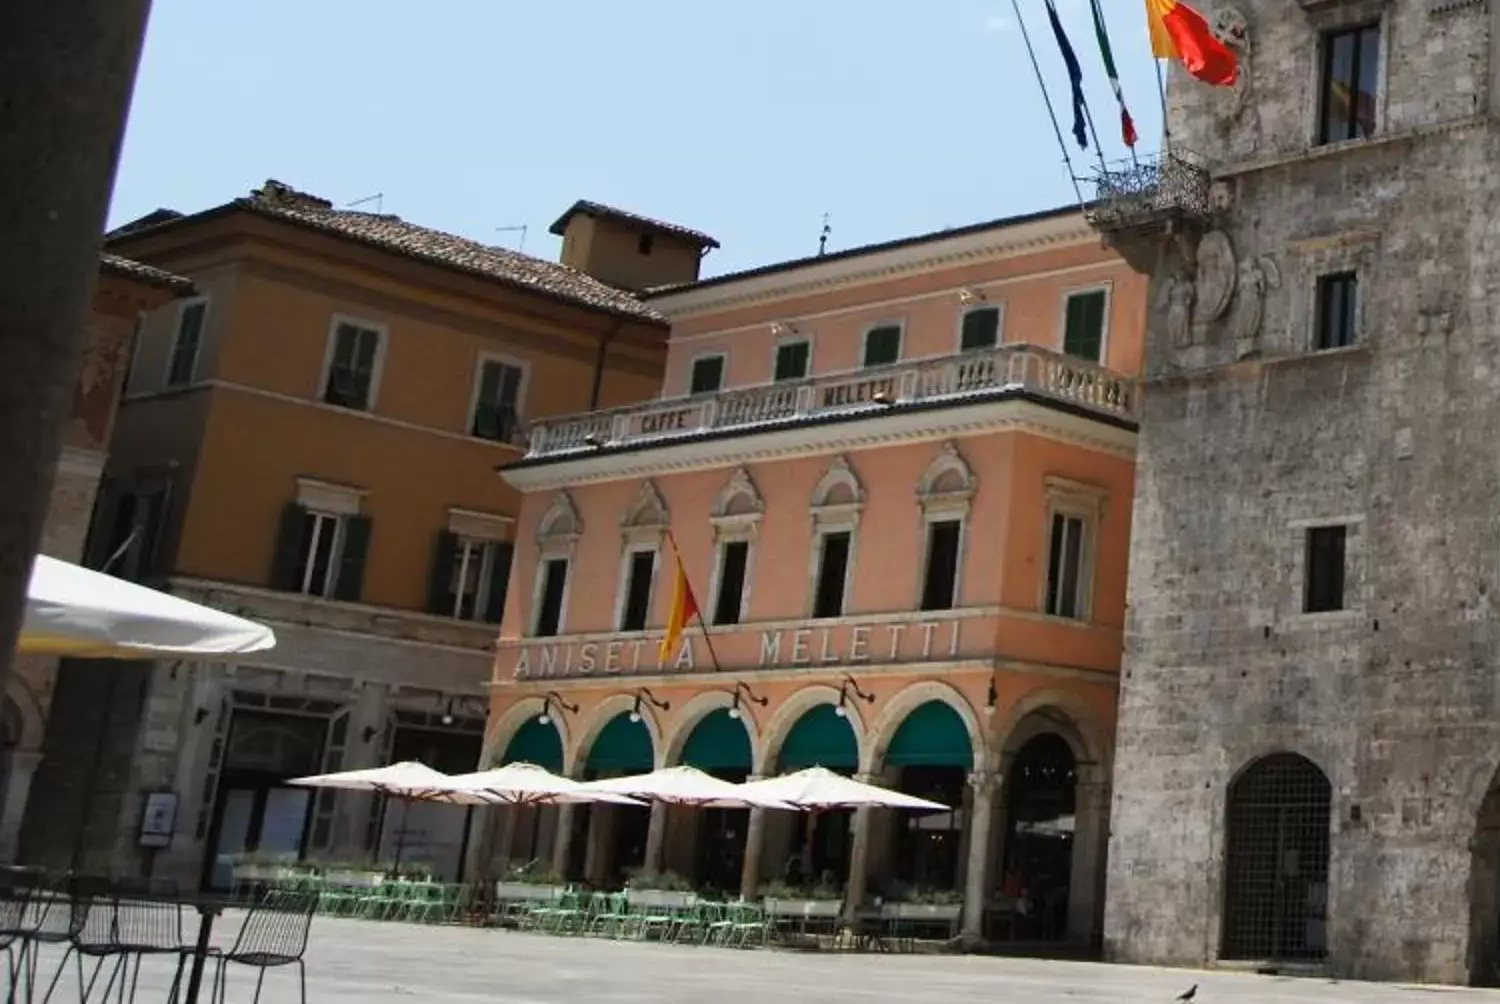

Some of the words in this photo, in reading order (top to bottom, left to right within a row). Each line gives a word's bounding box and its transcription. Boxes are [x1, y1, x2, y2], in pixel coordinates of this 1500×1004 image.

[824, 378, 895, 406] MELETTI
[514, 636, 696, 676] ANISETTA
[758, 620, 961, 665] MELETTI
